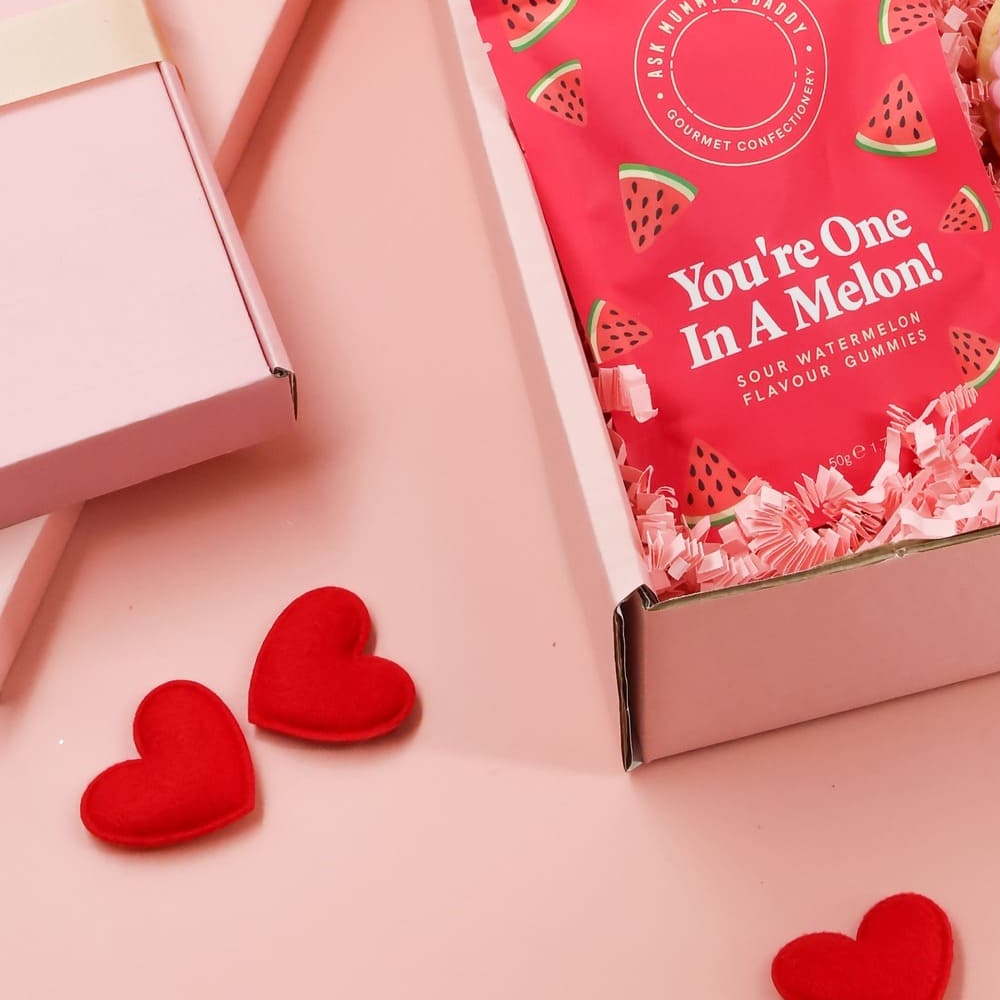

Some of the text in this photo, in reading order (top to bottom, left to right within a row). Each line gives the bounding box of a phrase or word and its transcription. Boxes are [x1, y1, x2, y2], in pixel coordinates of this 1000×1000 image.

[647, 43, 666, 79] ASK
[667, 66, 816, 152] GOURMET CONFECTIONERY
[668, 208, 912, 312] You're One
[680, 242, 943, 370] In A Melon!
[736, 311, 921, 388] SOUR WATERMELON
[742, 328, 928, 406] FLAVOUR GUMMIES
